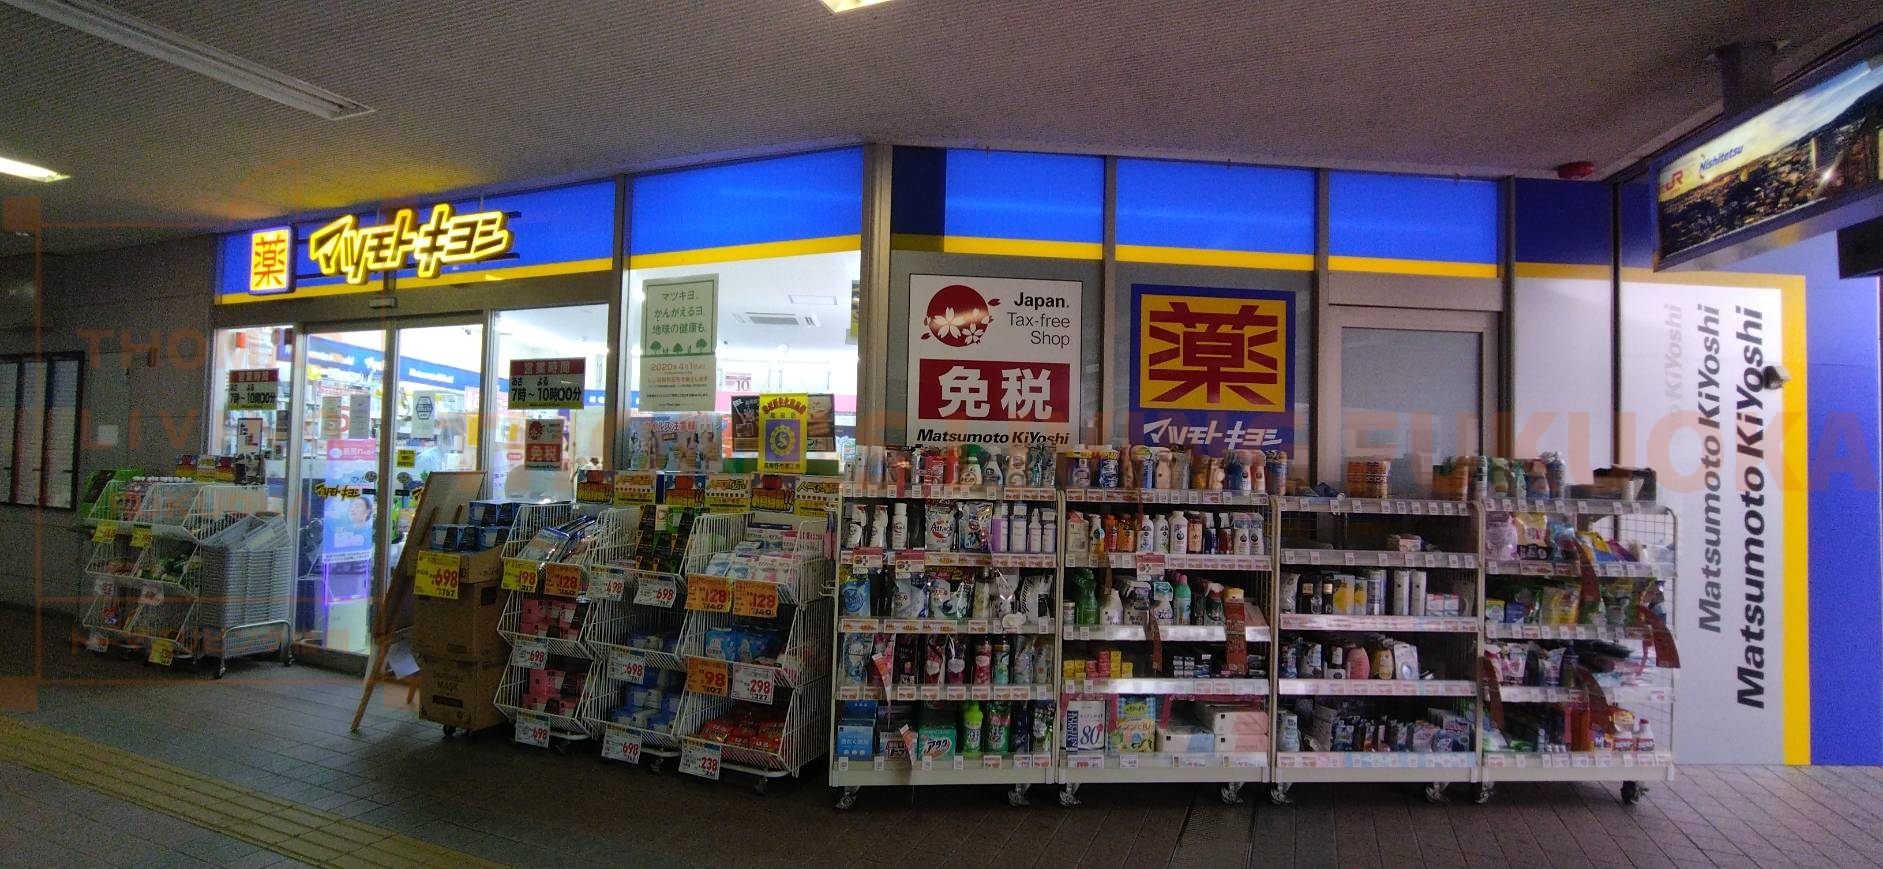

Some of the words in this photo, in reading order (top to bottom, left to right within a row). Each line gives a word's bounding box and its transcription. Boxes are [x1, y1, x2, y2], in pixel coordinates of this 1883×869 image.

[1664, 170, 1685, 191] JR
[1699, 144, 1745, 172] Nishitetsu
[253, 236, 287, 287] 薬
[309, 203, 513, 285] マツモトキヨシ
[1013, 291, 1071, 310] Japan.
[1007, 312, 1071, 329] Tax-free
[1030, 330, 1071, 349] Shop
[1147, 301, 1280, 406] 薬
[1664, 303, 1683, 403] KiYoshi
[524, 362, 570, 374] 営業時間
[1697, 305, 1722, 430] KiYoshi
[1735, 306, 1765, 460] KiYoshi
[937, 366, 1053, 420] 免税
[916, 428, 1009, 444] Matsumoto
[1012, 431, 1070, 446] KiYoshi
[1141, 416, 1284, 446] マツモトキヨシ
[531, 445, 557, 462] 免税
[1699, 434, 1722, 634] Matsumoto
[435, 567, 457, 588] 698
[656, 588, 674, 601] 698
[704, 588, 728, 604] 128
[1736, 466, 1766, 710] Matsumoto
[752, 591, 775, 608] 128
[530, 650, 545, 663] 698
[626, 662, 643, 676] 698
[705, 671, 726, 687] 98
[750, 679, 770, 694] 298
[622, 743, 639, 756] 698
[701, 756, 718, 771] 238
